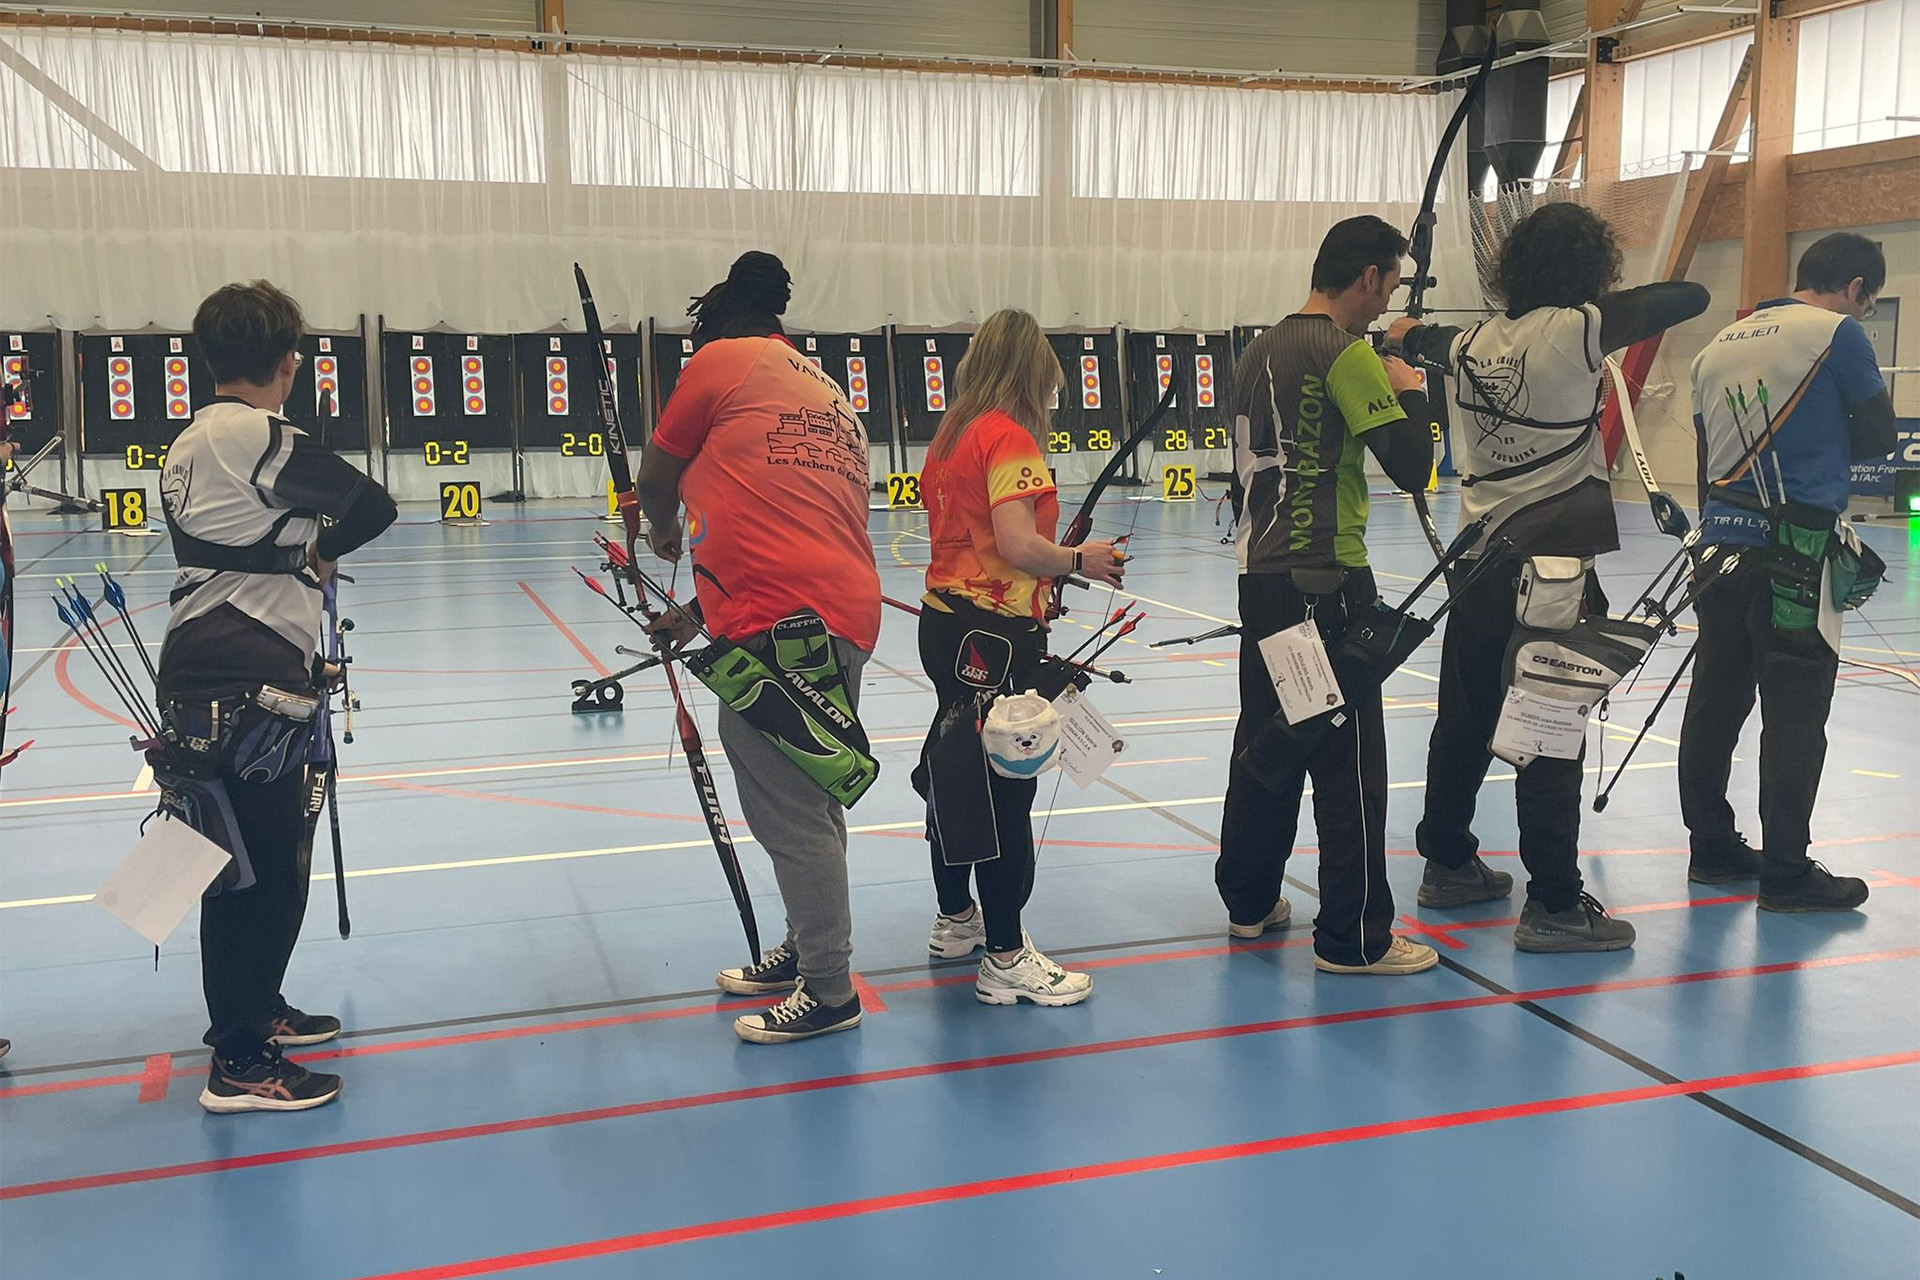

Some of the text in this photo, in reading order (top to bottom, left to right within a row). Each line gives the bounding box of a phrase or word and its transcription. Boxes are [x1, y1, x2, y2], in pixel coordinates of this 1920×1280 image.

[1719, 325, 1780, 342] JULIEN
[598, 379, 622, 455] KINETIC
[1049, 431, 1071, 452] 29
[1088, 429, 1111, 450] 28
[1165, 429, 1187, 450] 28
[1205, 428, 1227, 448] 27
[1430, 422, 1441, 441] 8
[425, 441, 468, 465] 0-2
[562, 433, 602, 455] 2-0
[767, 456, 789, 465] Les
[793, 457, 836, 473] Archers
[1635, 450, 1655, 486] HOYT
[1850, 464, 1875, 474] ation
[1165, 468, 1193, 496] 25
[1860, 473, 1881, 482] l'Arc
[443, 485, 479, 518] 20
[890, 477, 920, 505] 23
[105, 491, 143, 526] 18
[1714, 516, 1731, 525] TIR
[776, 618, 820, 630] CLASSIC
[1549, 659, 1603, 676] EASTON
[571, 679, 624, 713] 20
[784, 672, 852, 729] AVALON
[308, 771, 328, 811] FURY
[696, 762, 732, 845] FURY
